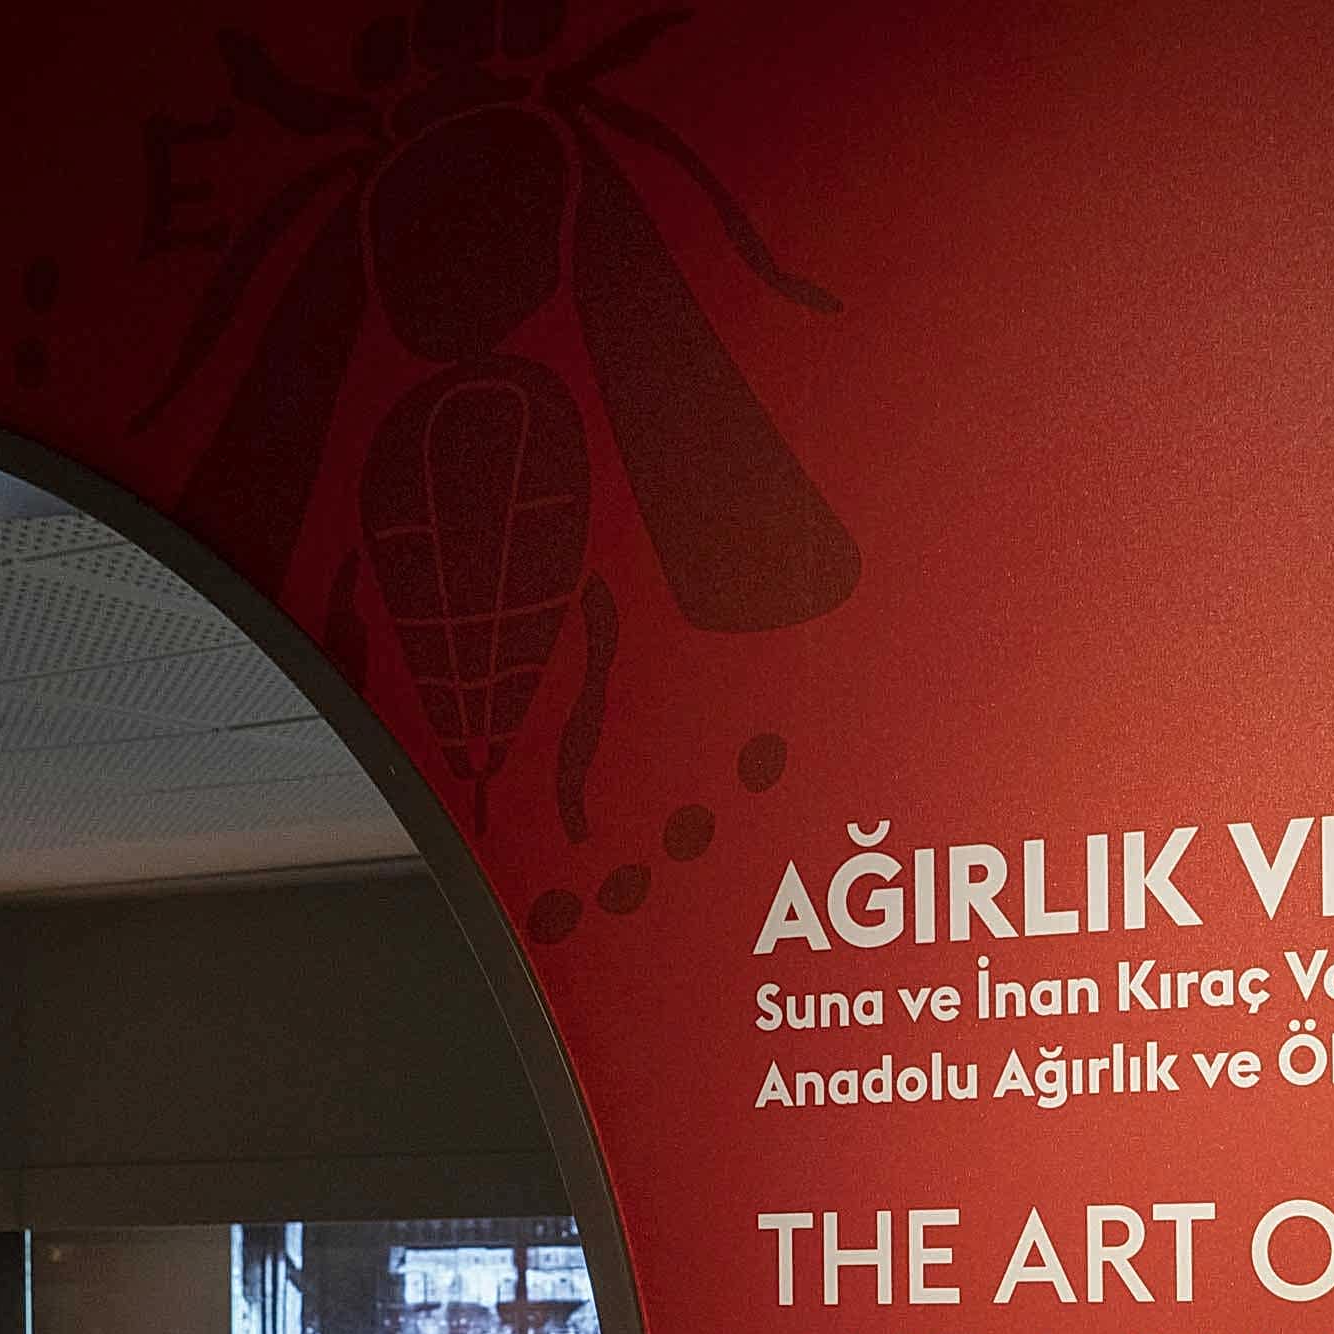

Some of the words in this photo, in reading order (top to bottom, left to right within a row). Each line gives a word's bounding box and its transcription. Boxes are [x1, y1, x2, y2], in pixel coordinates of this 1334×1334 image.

[753, 816, 1204, 955] AĞIRLIK
[755, 985, 884, 1031] Suna
[897, 985, 961, 1023] ve
[977, 955, 1100, 1019] İnan
[1118, 959, 1271, 1015] Kıraç
[754, 1052, 978, 1108] Anadolu
[992, 1040, 1181, 1109] Ağırlık
[1191, 1050, 1262, 1089] ve
[757, 1208, 961, 1306] THE
[992, 1202, 1216, 1304] ART
